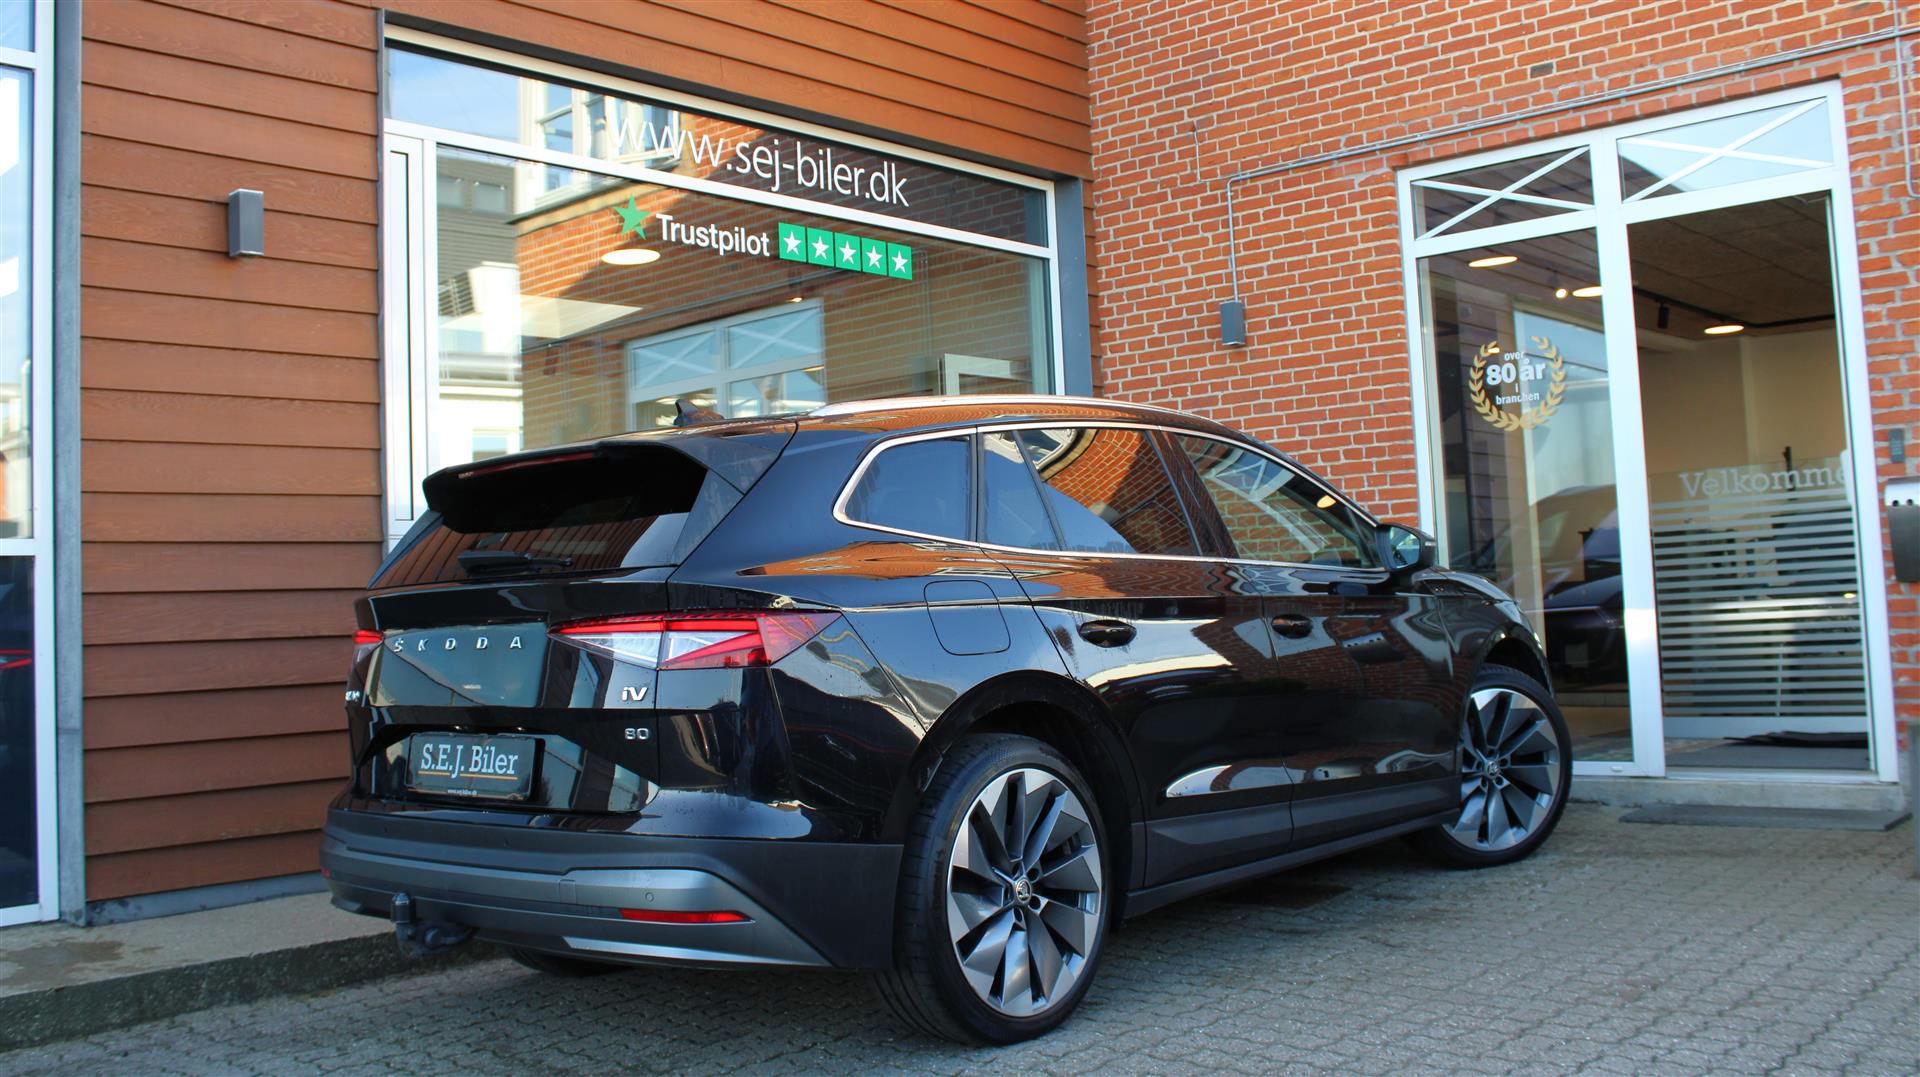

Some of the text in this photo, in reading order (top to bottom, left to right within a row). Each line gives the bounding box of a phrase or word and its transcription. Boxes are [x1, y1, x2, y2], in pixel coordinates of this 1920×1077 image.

[614, 117, 909, 207] www.sej-biler.dk
[656, 213, 770, 257] Trustpilot
[1504, 351, 1525, 361] over
[1486, 358, 1546, 385] 80 år
[1496, 391, 1540, 405] branchen
[624, 727, 649, 740] 80
[420, 743, 518, 779] S.E.J. Biler
